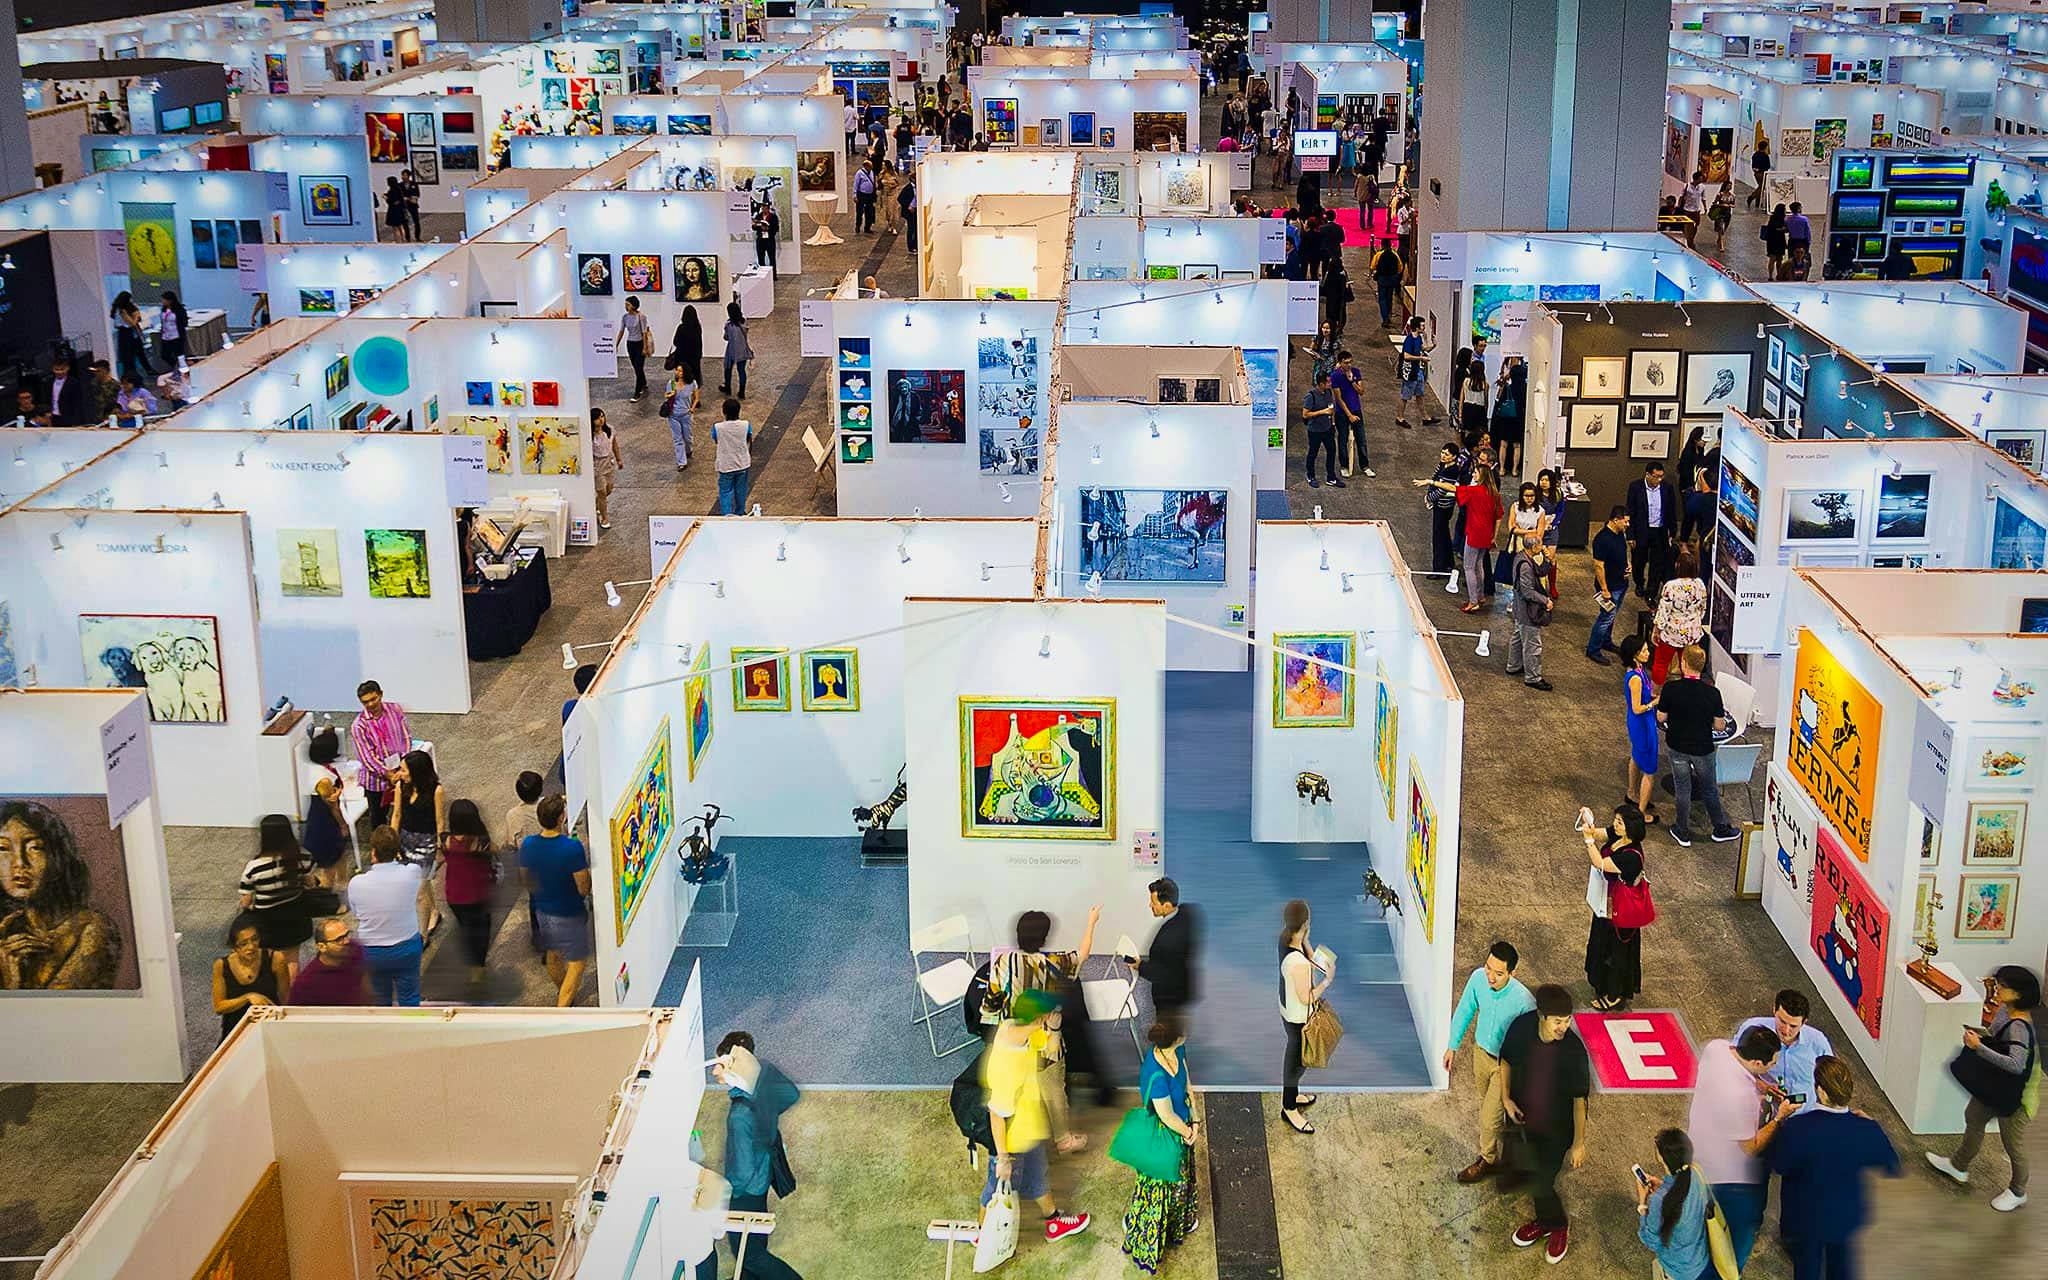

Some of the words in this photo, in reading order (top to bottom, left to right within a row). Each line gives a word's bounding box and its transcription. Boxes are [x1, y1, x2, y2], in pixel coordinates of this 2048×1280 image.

[139, 543, 190, 554] WODRA
[654, 539, 677, 547] Palma
[1926, 739, 1948, 765] UTTERLY
[1935, 762, 1947, 776] ART
[1815, 840, 1882, 952] RELAX
[1603, 1019, 1679, 1081] E
